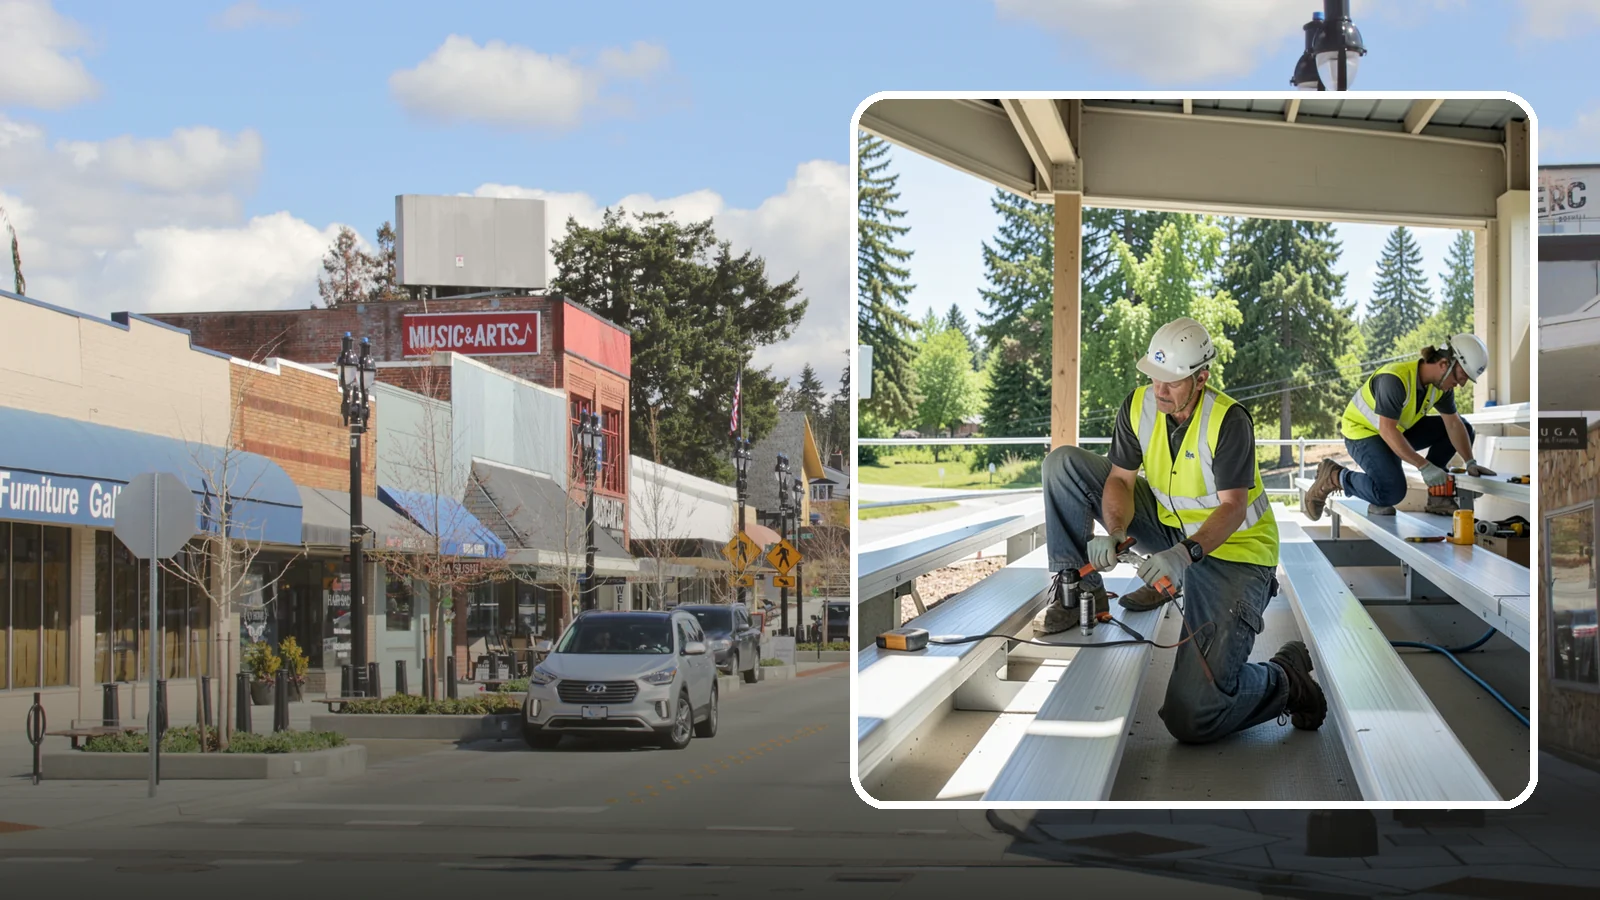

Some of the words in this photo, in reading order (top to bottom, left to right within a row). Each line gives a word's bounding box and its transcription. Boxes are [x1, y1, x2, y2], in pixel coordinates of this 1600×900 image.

[409, 323, 519, 348] MUSIC&ARTS
[0, 471, 79, 515] Furniture
[89, 482, 122, 519] Gal
